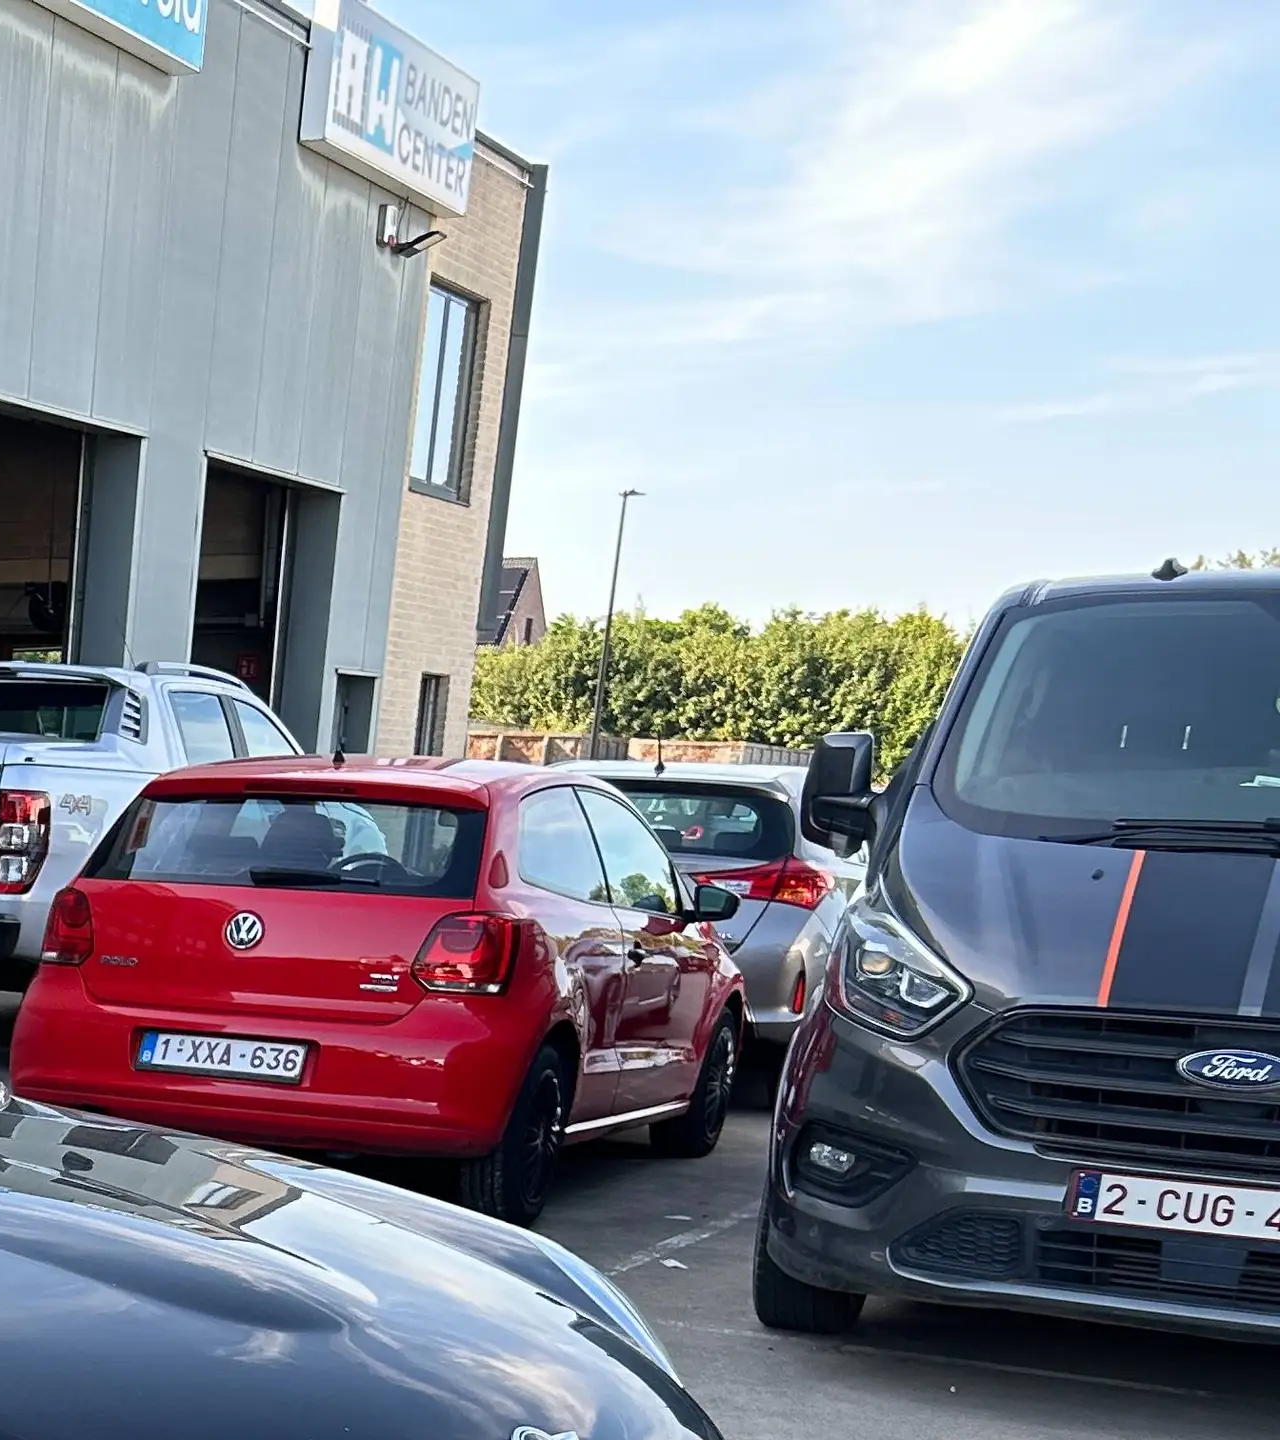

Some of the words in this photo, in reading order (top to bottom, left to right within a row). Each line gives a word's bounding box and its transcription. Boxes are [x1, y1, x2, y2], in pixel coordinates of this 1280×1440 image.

[404, 63, 475, 142] BANDEN
[397, 123, 467, 197] CENTER
[1201, 1054, 1274, 1083] Ford
[1076, 1197, 1093, 1213] B
